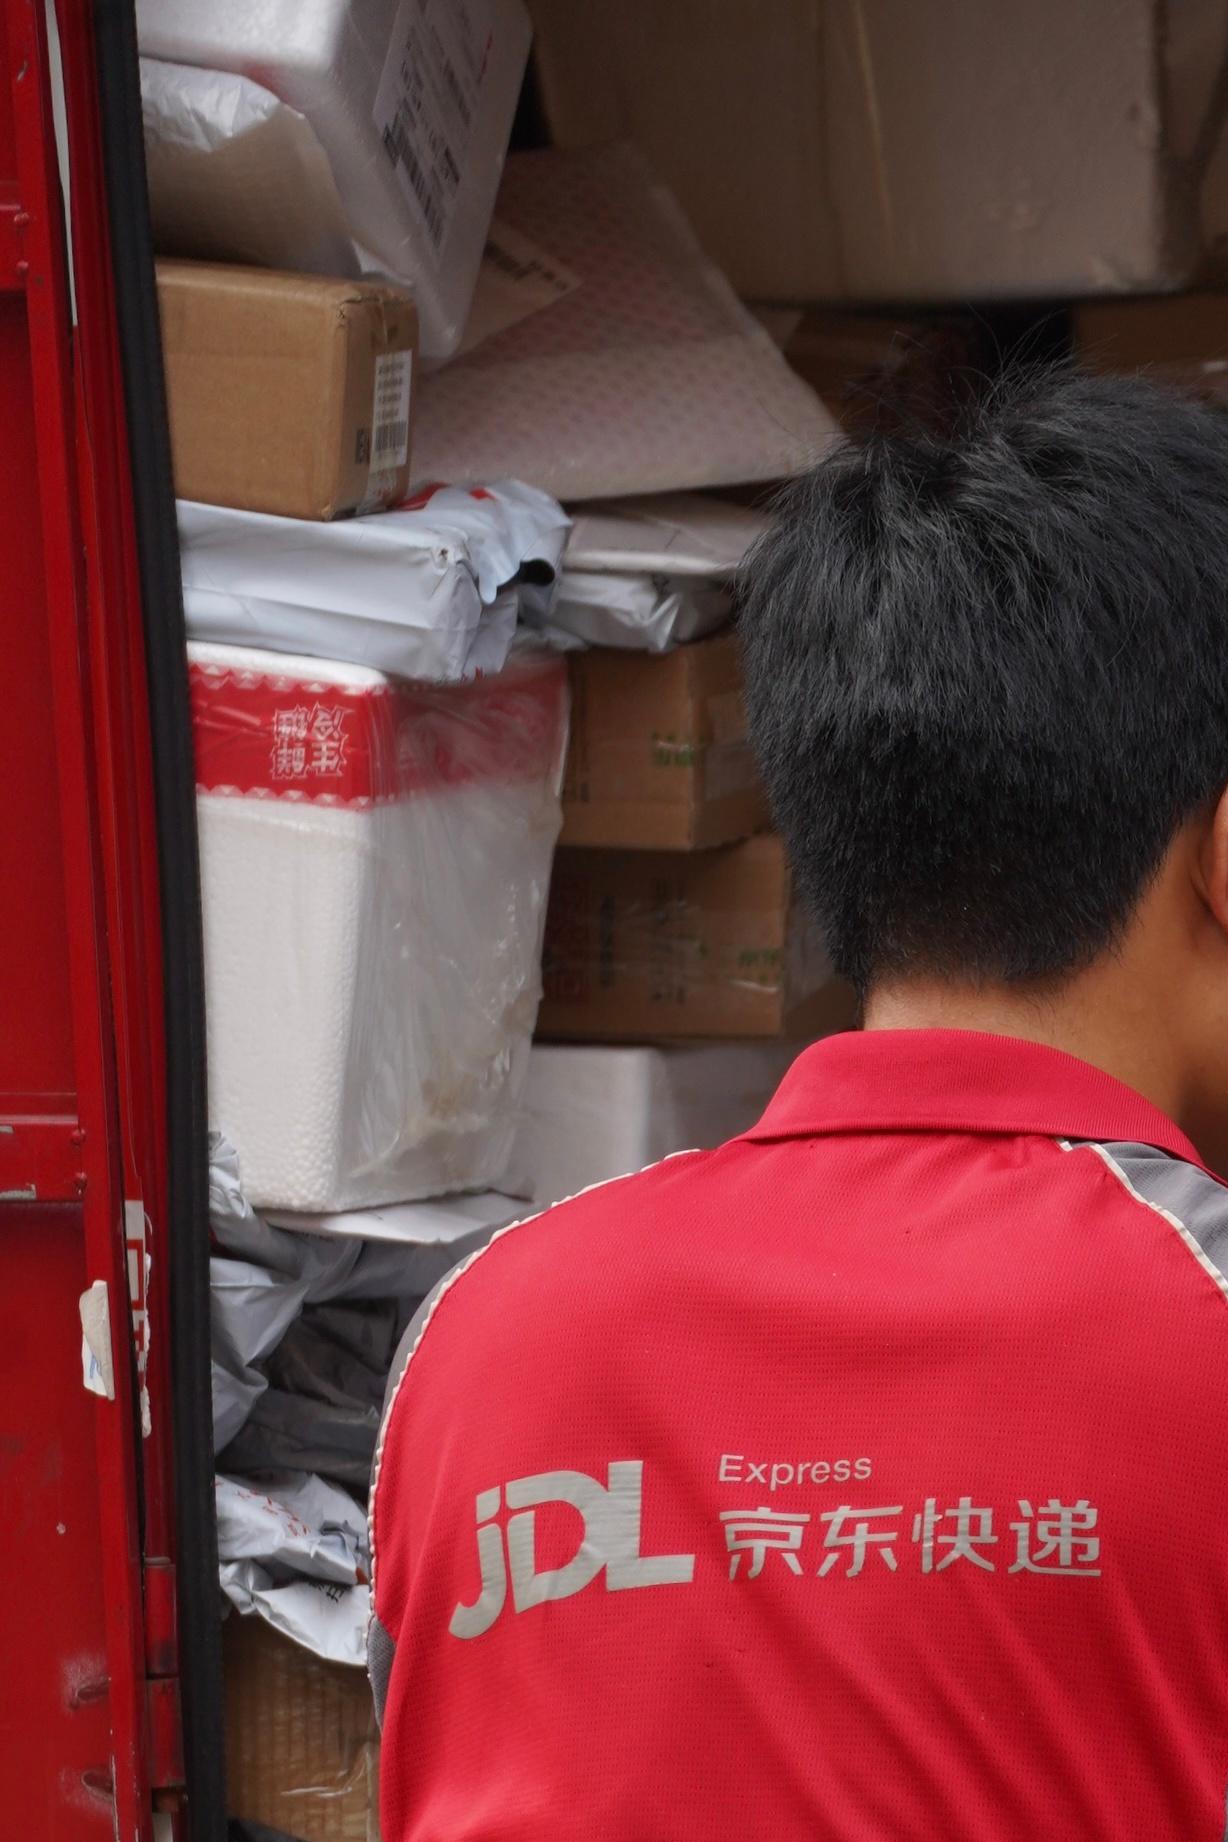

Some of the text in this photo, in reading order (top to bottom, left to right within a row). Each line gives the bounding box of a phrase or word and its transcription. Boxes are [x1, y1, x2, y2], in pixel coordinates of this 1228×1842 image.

[717, 1453, 873, 1489] Express
[718, 1496, 1102, 1582] 京东快递
